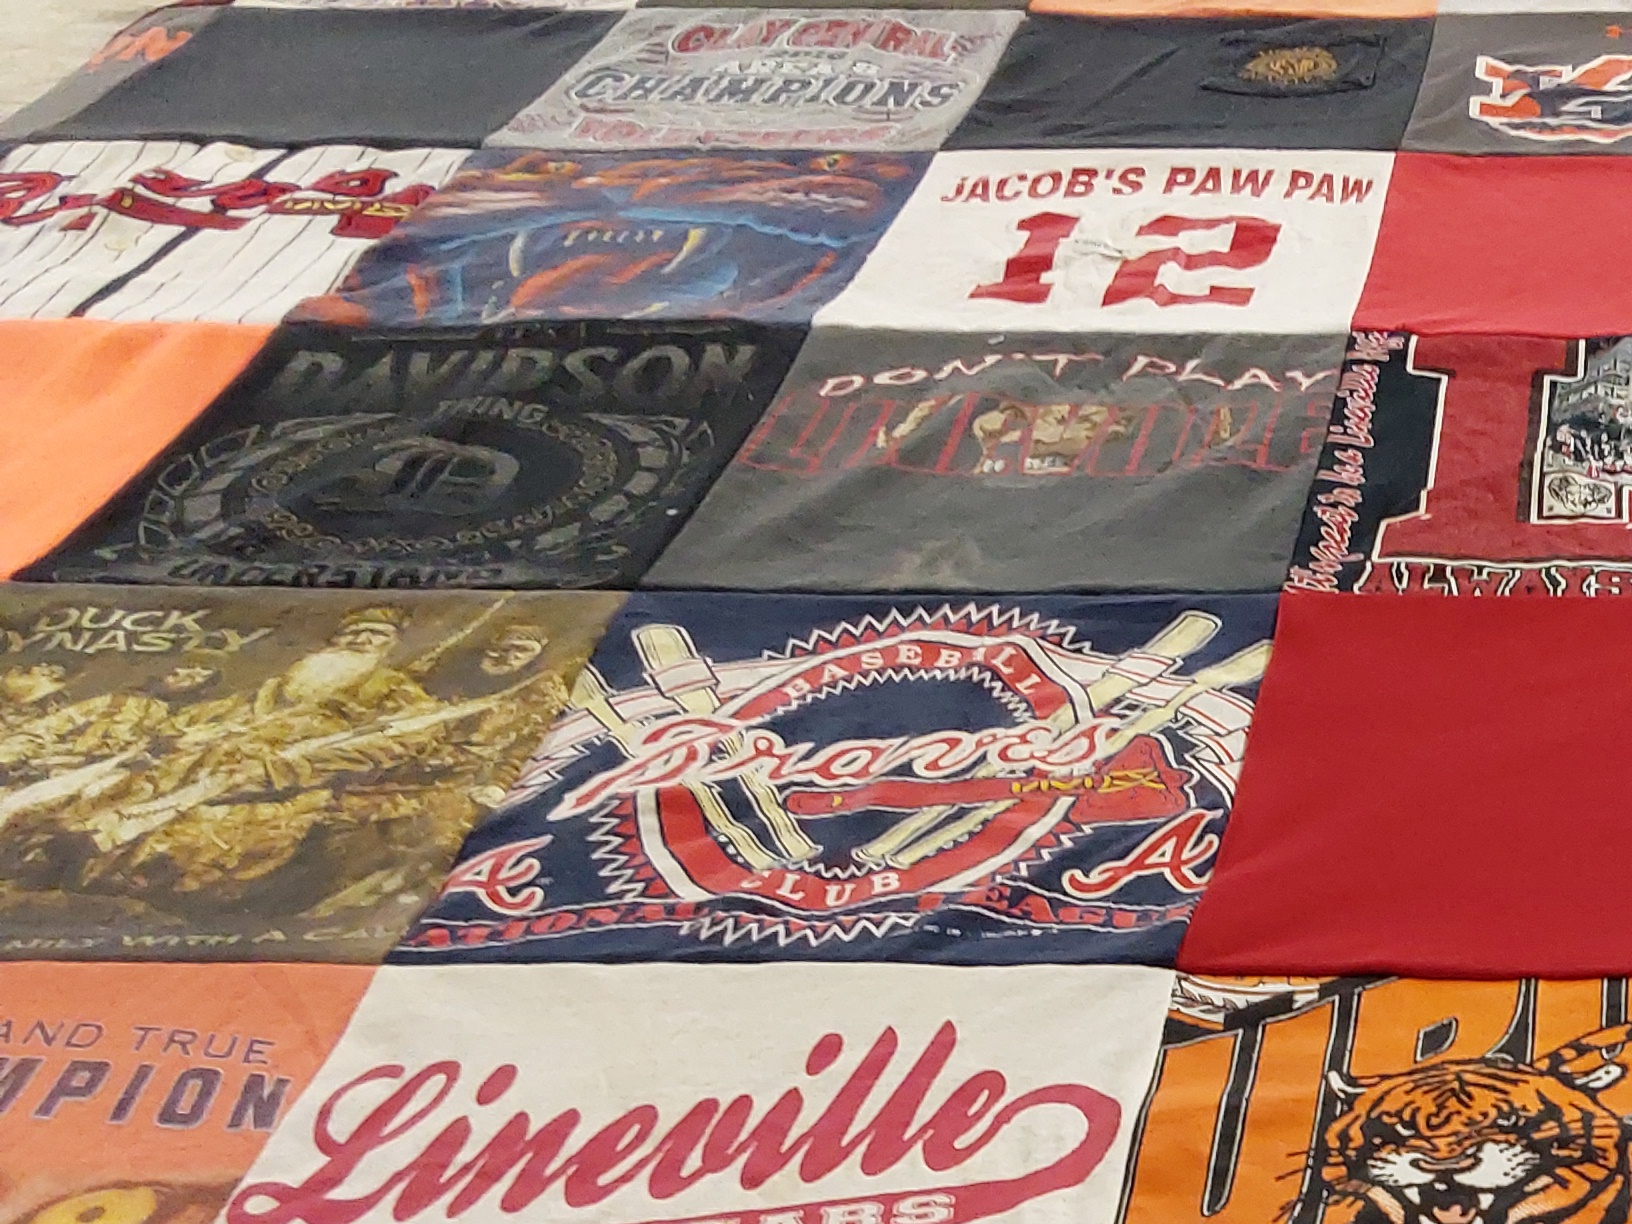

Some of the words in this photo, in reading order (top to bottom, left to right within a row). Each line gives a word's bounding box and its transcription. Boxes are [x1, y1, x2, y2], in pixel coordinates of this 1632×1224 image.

[571, 70, 965, 109] CHAMPIONS
[941, 167, 1147, 203] JACOB'S
[1163, 166, 1274, 199] PAW
[1283, 169, 1375, 206] PAW
[967, 211, 1283, 308] 12
[818, 353, 1104, 396] DON'T
[1122, 354, 1340, 391] PLAY
[37, 606, 213, 632] DUCK
[784, 641, 1044, 703] BASEBALL
[548, 712, 1120, 821] Braves
[739, 868, 901, 909] CLUB
[134, 1026, 276, 1065] TRUE
